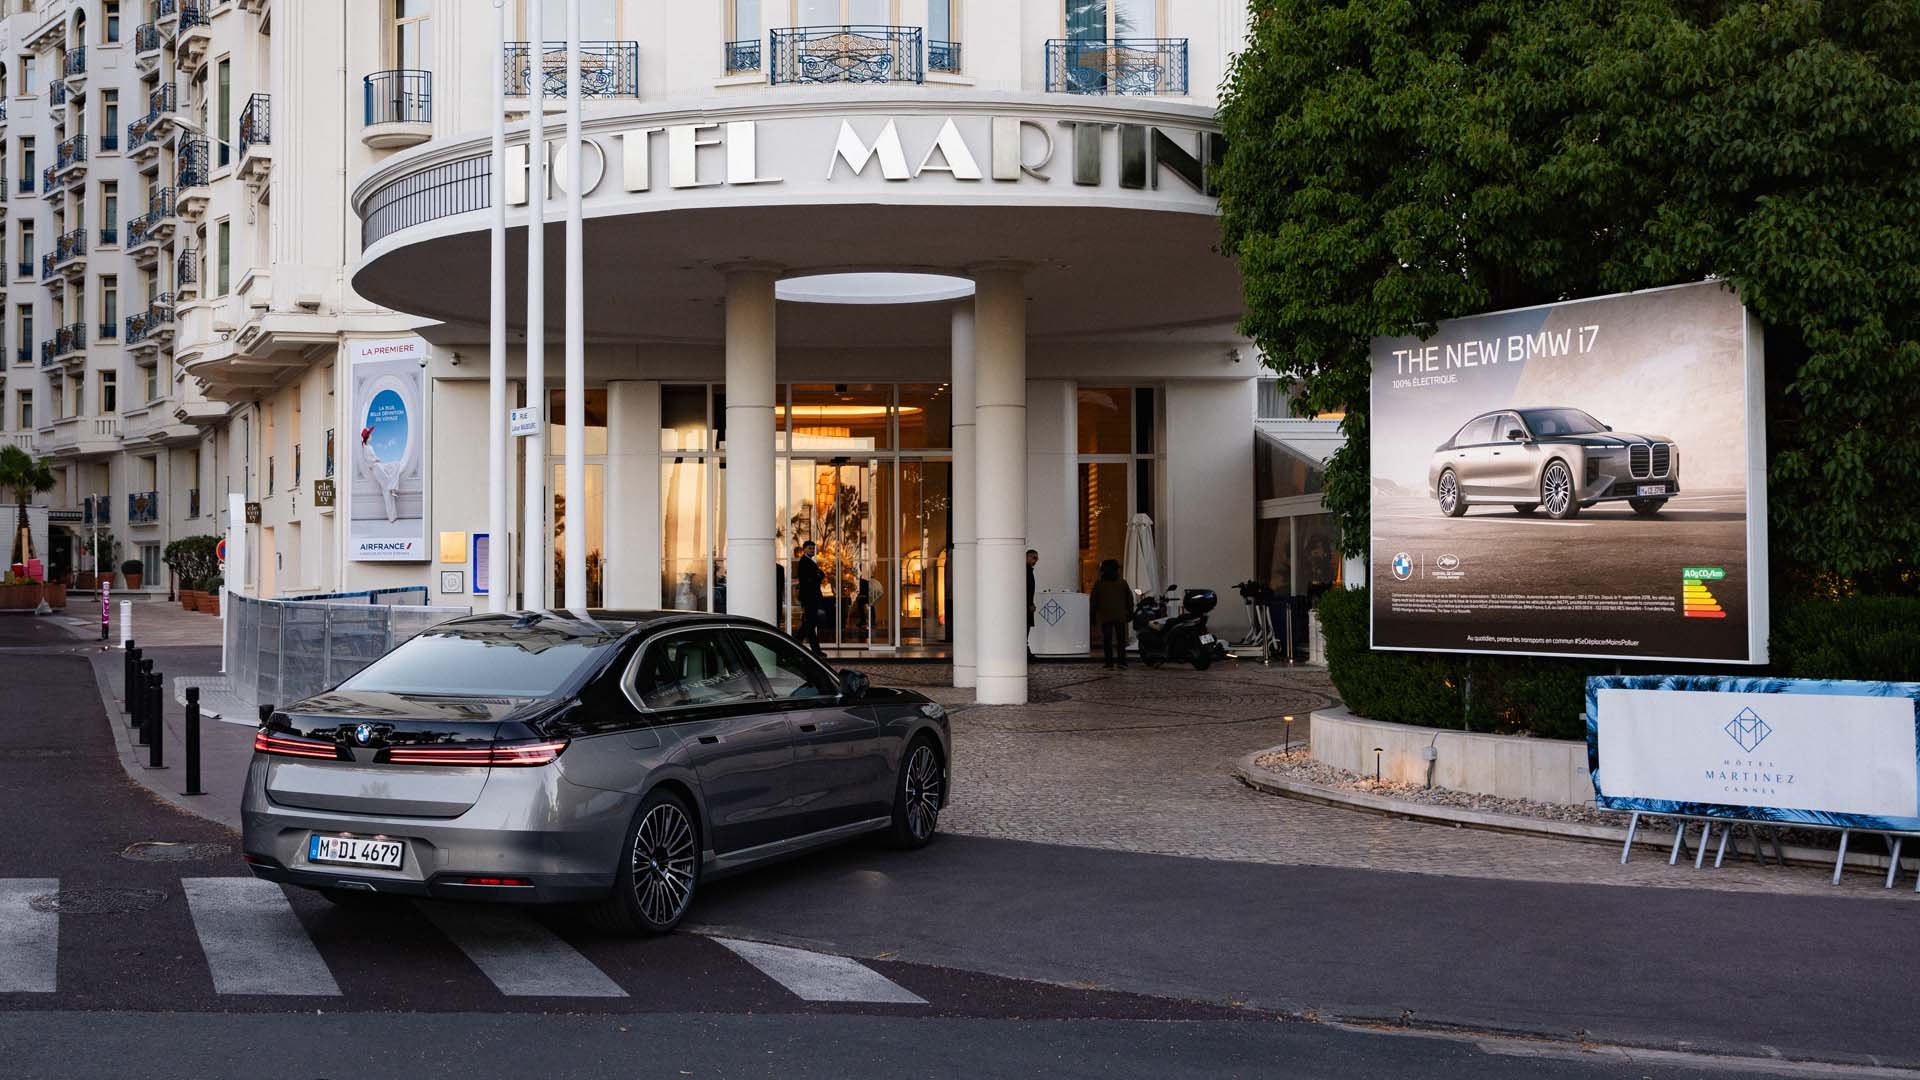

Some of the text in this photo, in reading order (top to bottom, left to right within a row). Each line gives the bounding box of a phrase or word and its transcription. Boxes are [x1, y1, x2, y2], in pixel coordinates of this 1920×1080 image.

[505, 120, 784, 206] HOTEL
[361, 348, 373, 356] LA
[1392, 325, 1600, 374] THE NEW BMW i7
[1392, 379, 1411, 389] 100%
[318, 482, 330, 491] ele
[320, 496, 329, 504] ty
[1705, 770, 1795, 784] MARTINEZ
[1724, 786, 1775, 794] CANNES
[320, 839, 399, 863] M DI 4679
